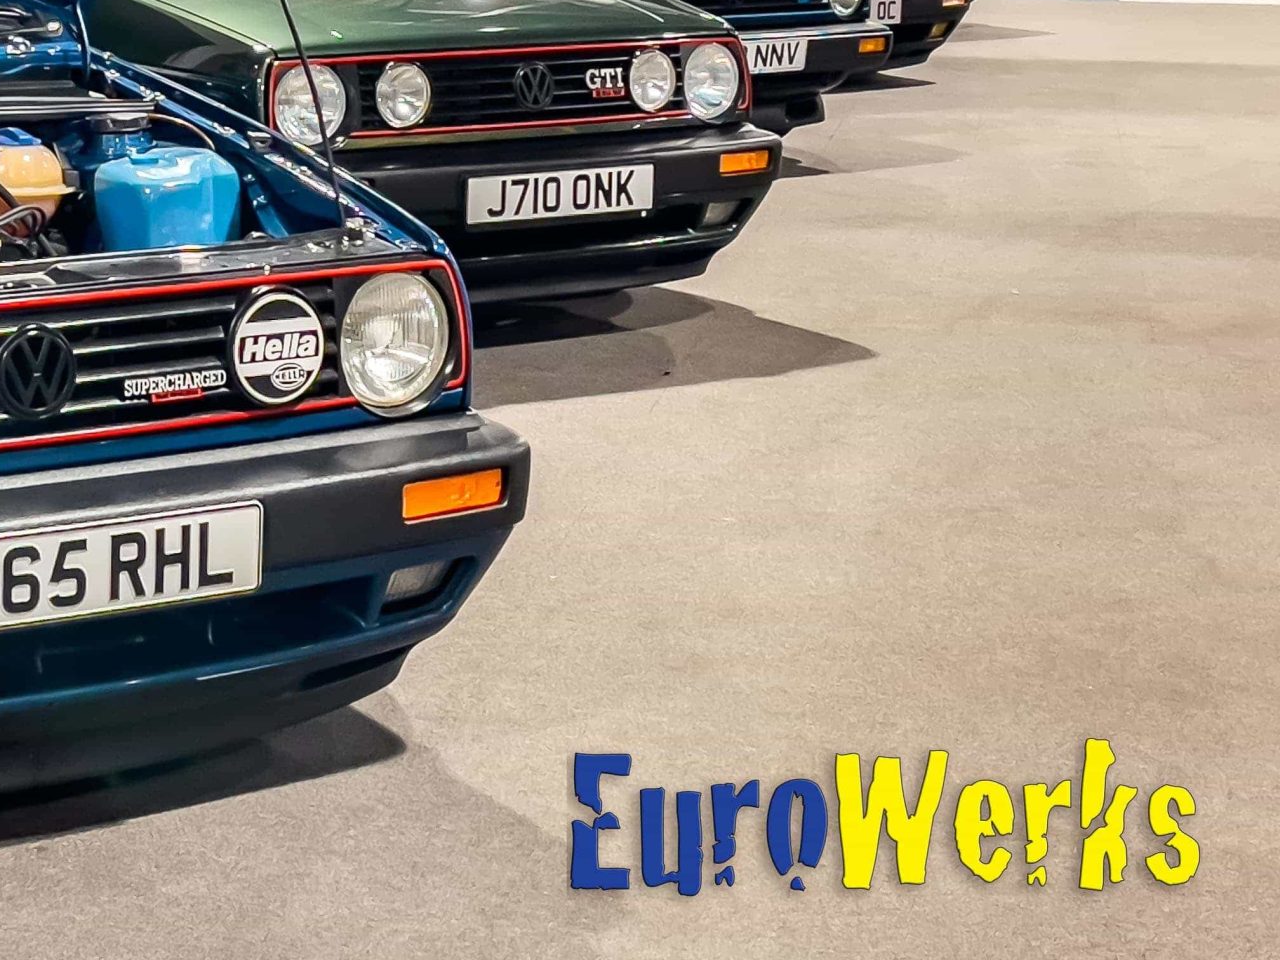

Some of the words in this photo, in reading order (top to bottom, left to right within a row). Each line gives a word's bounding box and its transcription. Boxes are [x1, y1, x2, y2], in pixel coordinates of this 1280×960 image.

[753, 41, 800, 67] NNV
[585, 67, 625, 89] GTI
[487, 176, 561, 217] J710
[572, 170, 635, 210] ONK
[242, 333, 317, 363] Hella
[124, 369, 227, 397] SUPERCHARGED
[110, 522, 234, 601] RHL
